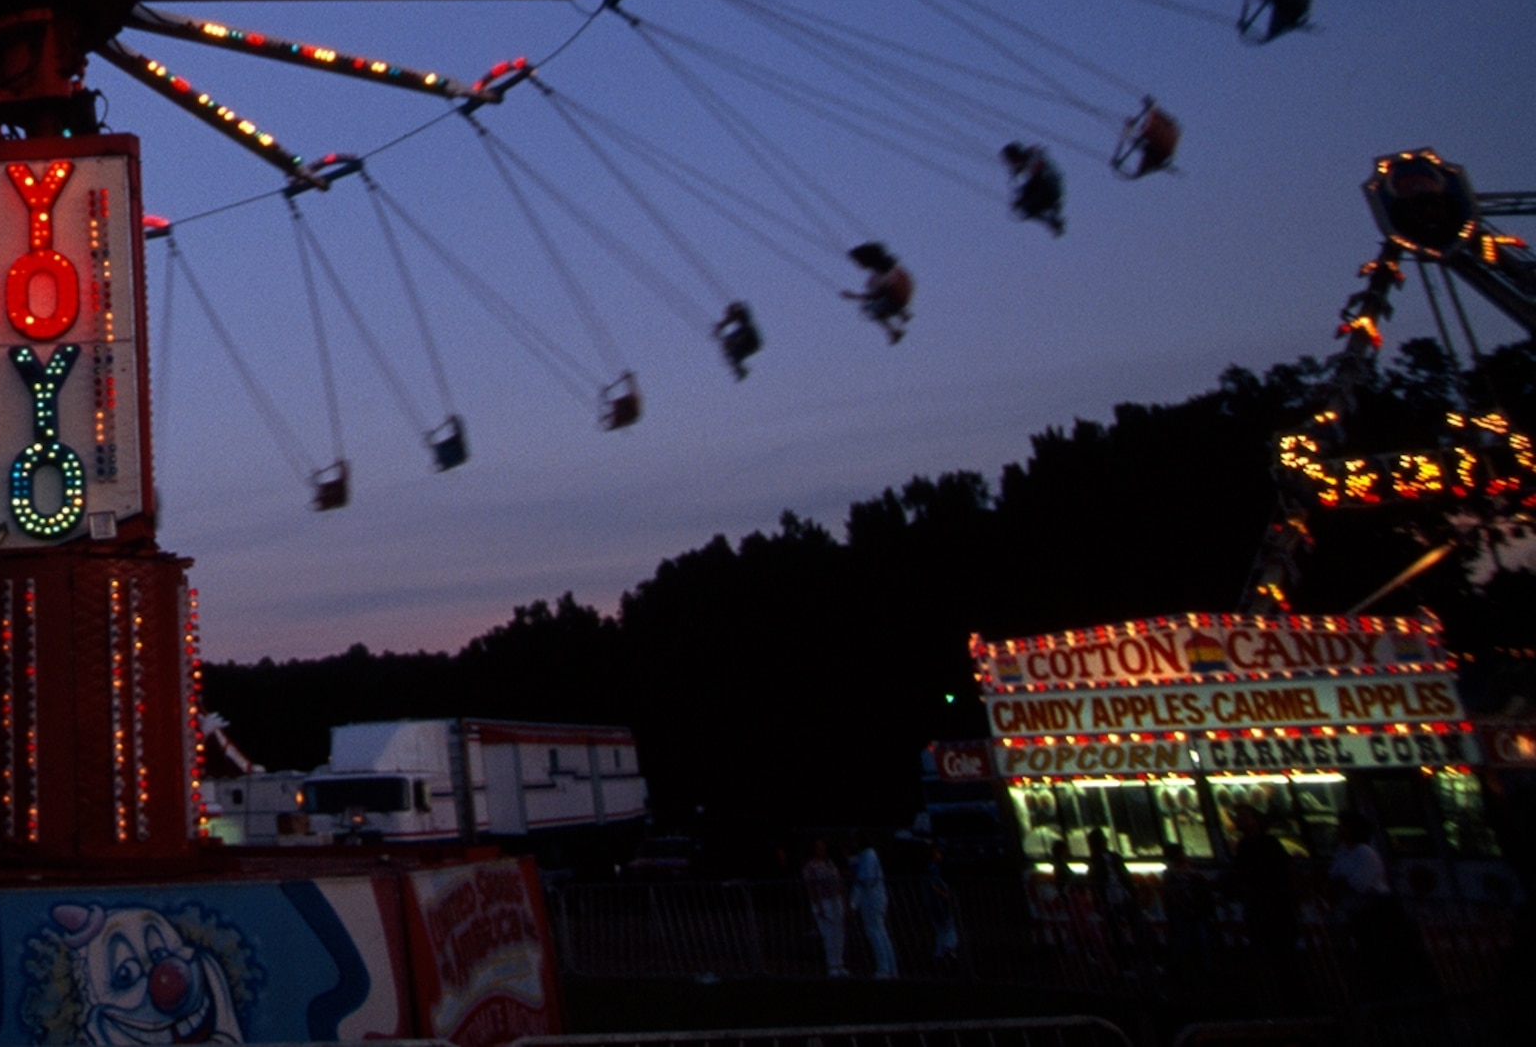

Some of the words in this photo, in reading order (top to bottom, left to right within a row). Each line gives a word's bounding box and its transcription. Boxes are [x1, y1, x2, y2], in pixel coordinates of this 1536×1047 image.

[1027, 633, 1185, 680] COTTON
[1227, 630, 1381, 669] CANDY
[993, 698, 1084, 733] CANDY
[1211, 687, 1329, 724] CARMEL
[1334, 682, 1457, 720] APPLES
[943, 750, 983, 777] Coke
[1005, 743, 1180, 773] POPCORN
[1209, 736, 1353, 766] CARMEL
[1369, 734, 1464, 762] CORN
